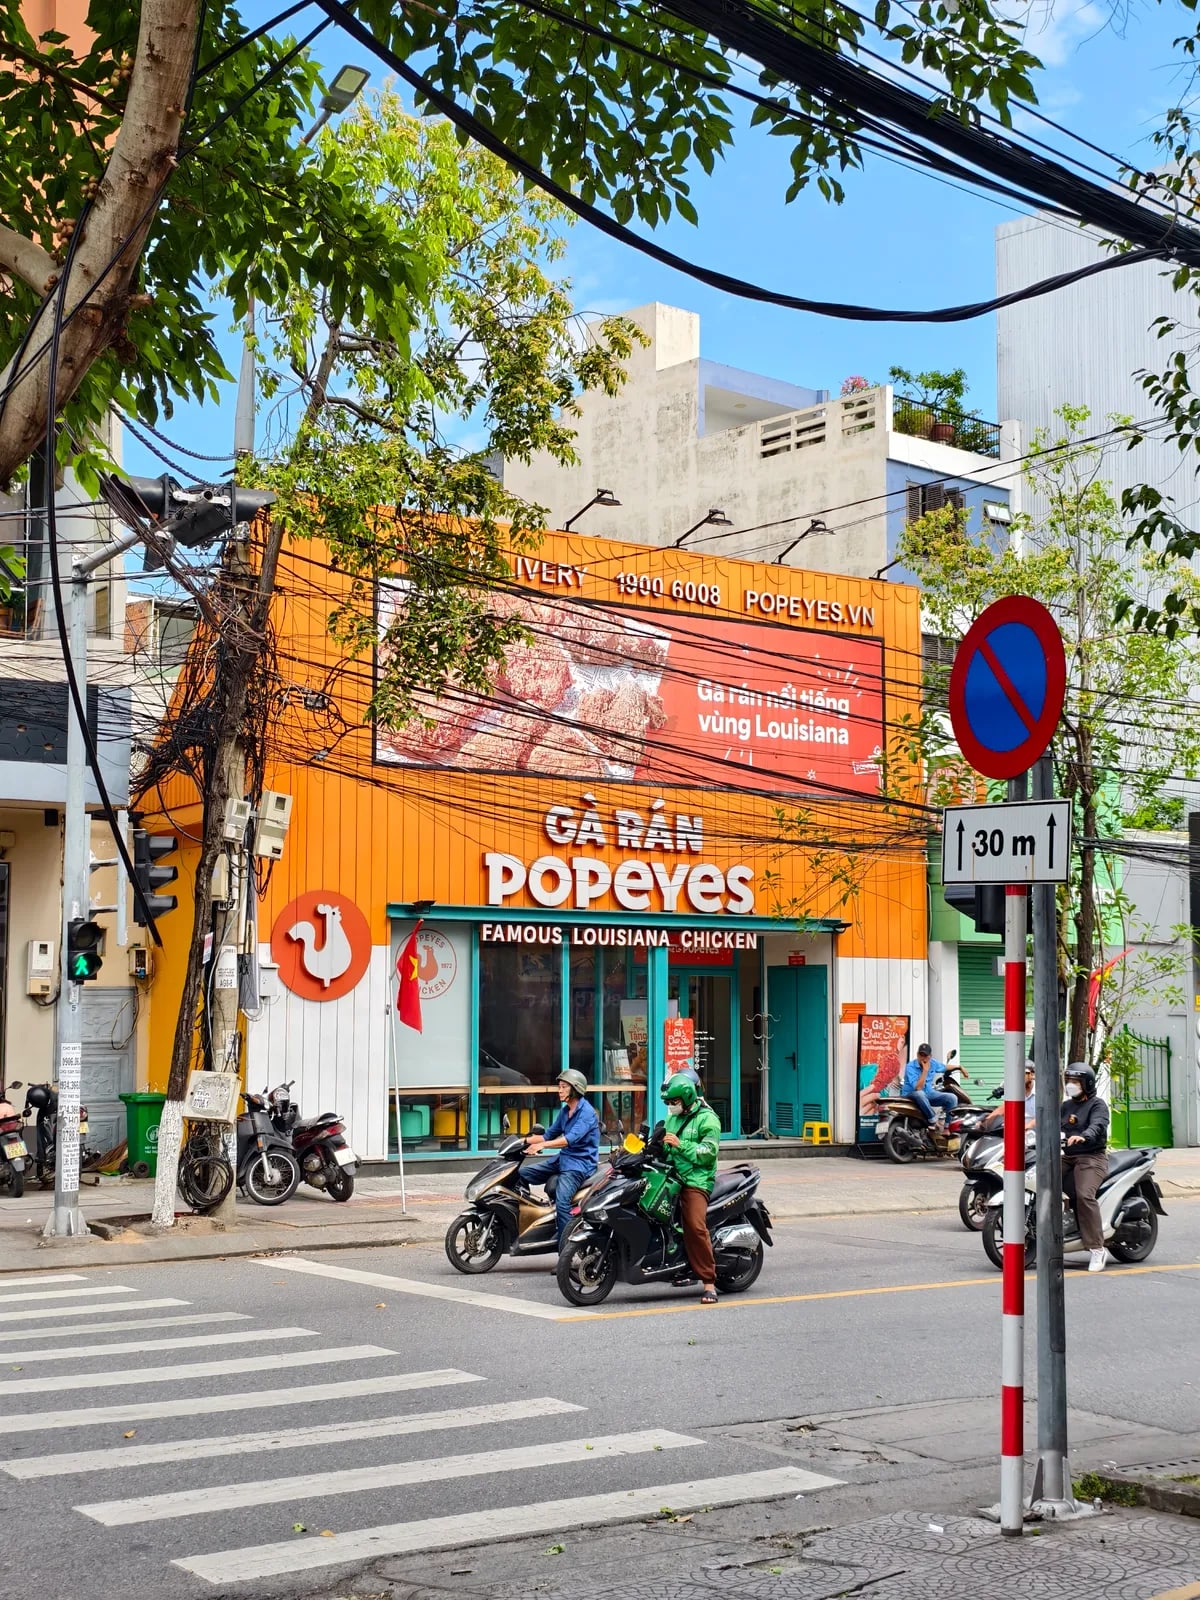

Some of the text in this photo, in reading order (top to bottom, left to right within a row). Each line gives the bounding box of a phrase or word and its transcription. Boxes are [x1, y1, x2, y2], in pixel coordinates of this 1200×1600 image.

[616, 571, 664, 598] 1900
[671, 579, 721, 606] 6008
[745, 589, 875, 627] POPEYES.VN
[698, 710, 849, 745] vùng Louisiana
[545, 791, 703, 853] GÀ RÁN
[974, 828, 1035, 857] 30 m
[481, 923, 757, 951] FAMOUS LOUISIANA CHICKEN
